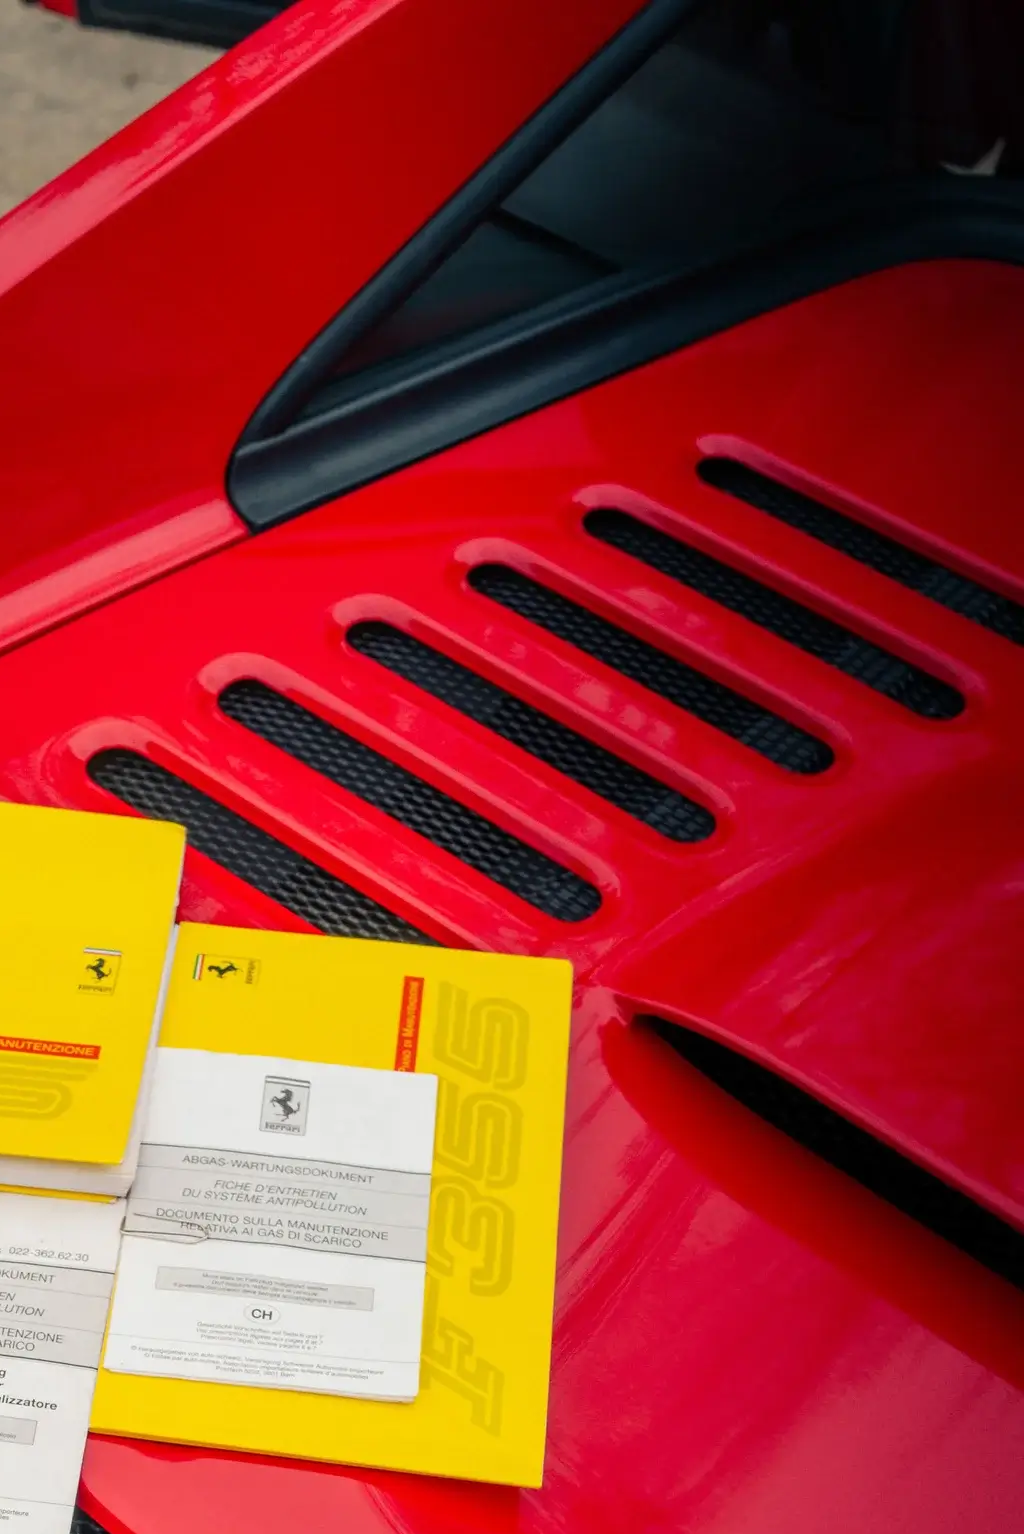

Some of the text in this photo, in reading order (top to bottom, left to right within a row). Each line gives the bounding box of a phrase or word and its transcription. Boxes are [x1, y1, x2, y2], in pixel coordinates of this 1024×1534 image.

[181, 1153, 374, 1185] ABGAS-WARTUNGSDOKUMENT
[181, 1186, 201, 1199] DU
[265, 1195, 367, 1216] ANTIPOLLUTION
[213, 1179, 337, 1201] FICHE D'ENTRETIEN
[155, 1206, 388, 1241] DOCUMENTO SULLA MANUTENZIONE
[421, 980, 530, 1437] F355
[240, 1227, 254, 1237] AI
[256, 1228, 284, 1240] GAS
[287, 1231, 300, 1242] DI
[303, 1233, 362, 1249] SCARICO
[250, 1307, 273, 1320] CH
